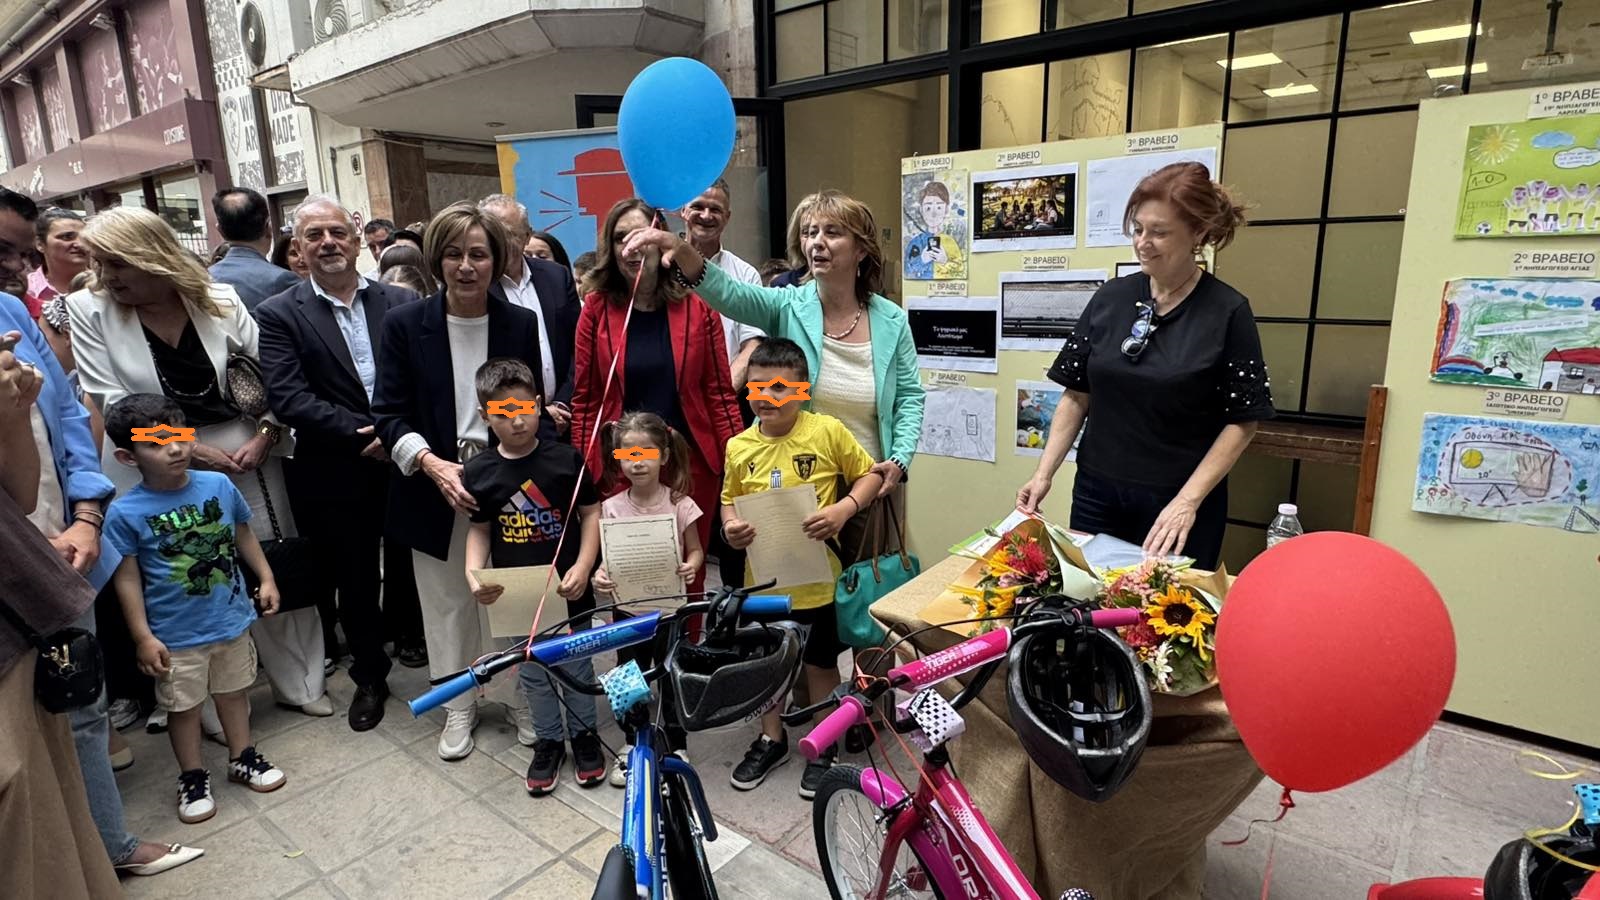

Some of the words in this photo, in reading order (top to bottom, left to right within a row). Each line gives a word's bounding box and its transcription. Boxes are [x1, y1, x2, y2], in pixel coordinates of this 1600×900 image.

[1532, 252, 1596, 264] ΒΡΑΒΕΙΟ
[1504, 393, 1564, 406] ΒΡΑΒΕΙΟ
[498, 508, 561, 528] adidas
[567, 639, 601, 656] TIGER
[924, 652, 956, 669] TIGER
